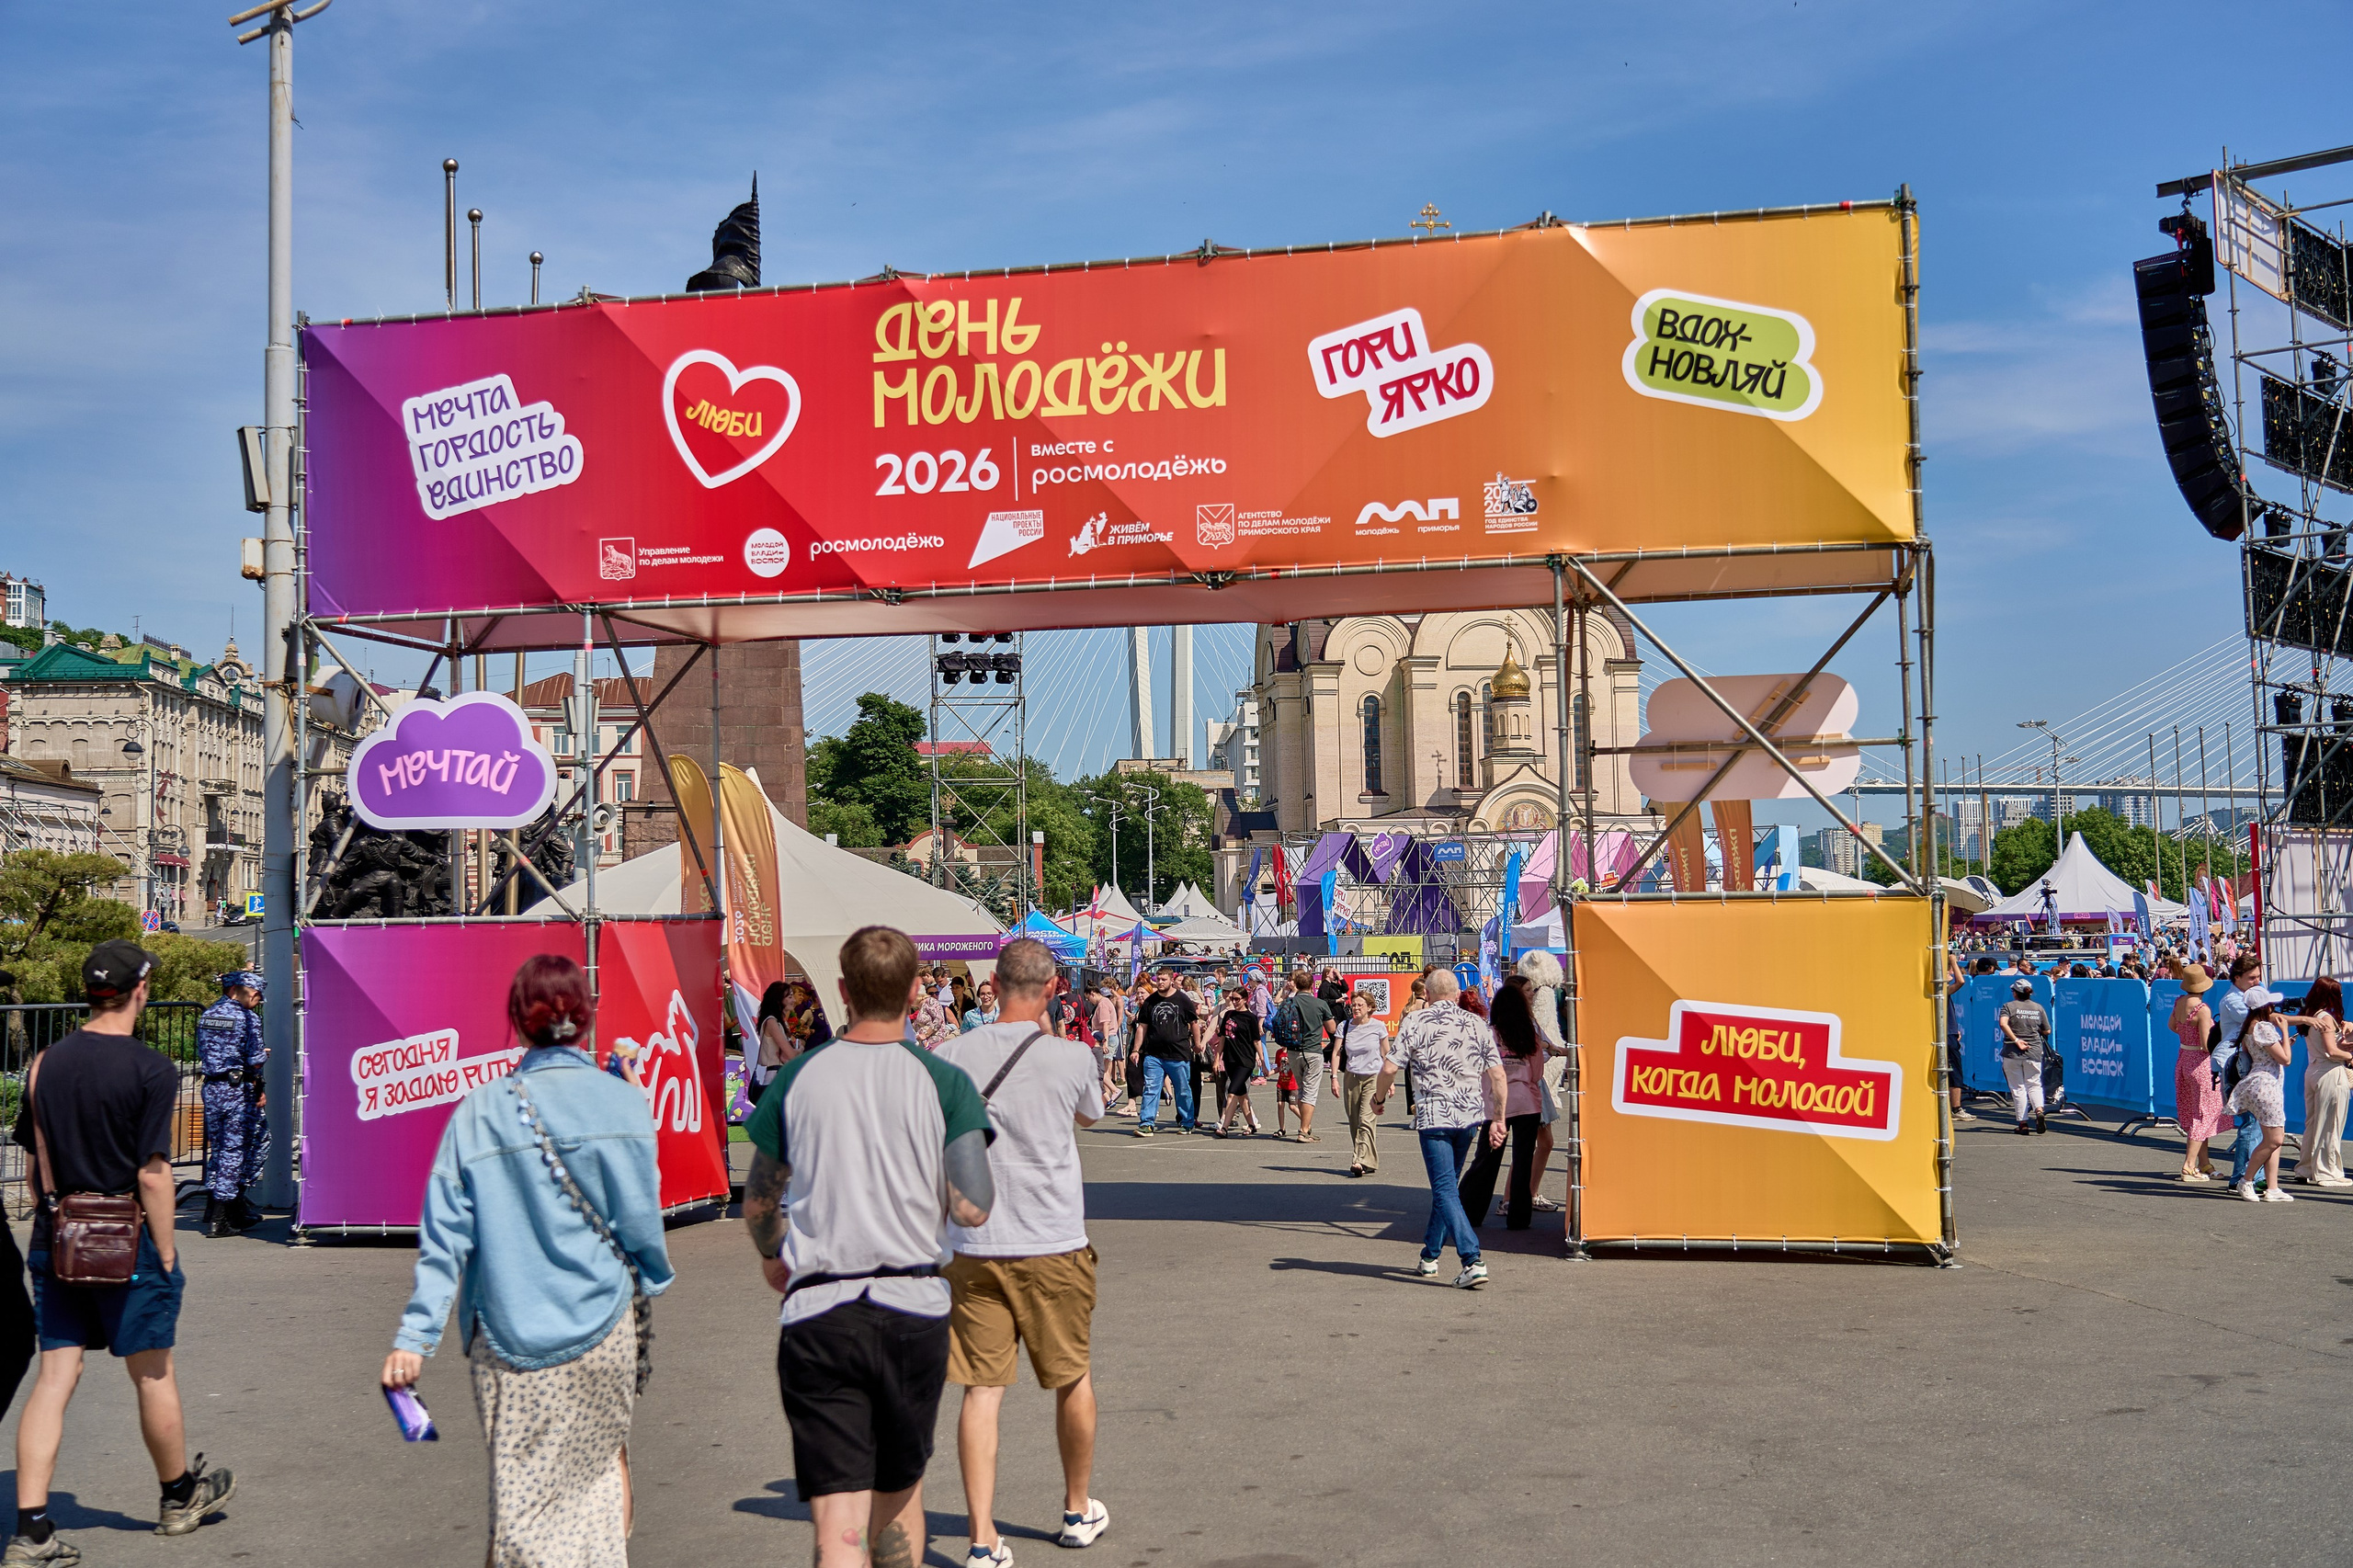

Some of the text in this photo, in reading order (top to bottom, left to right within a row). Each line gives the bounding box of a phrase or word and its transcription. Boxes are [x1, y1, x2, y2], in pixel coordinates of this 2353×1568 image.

[873, 298, 1041, 363] ДЕНЬ
[1656, 308, 1752, 352] ВДОХ-
[1321, 322, 1417, 384] ГОРИ
[1648, 347, 1787, 400] НОВЛЯЙ
[873, 341, 1226, 427] МОЛОДЁЖИ
[1380, 358, 1480, 425] ЯРКО
[413, 385, 510, 434] МЕЧТА
[685, 400, 763, 437] ЛЮБИ
[418, 413, 555, 472] ГОРДОСТЬ
[1031, 439, 1114, 457] вместе с
[426, 445, 574, 510] ЕДИНСТВО
[875, 449, 1000, 495] 2026
[1032, 454, 1226, 494] росмолодёжь
[1483, 486, 1501, 500] 20
[1238, 511, 1282, 519] АГЕНТСТВО
[1483, 500, 1501, 513] 26
[991, 511, 1041, 521] НАЦИОНАЛЬНЫЕ
[1013, 520, 1041, 528] ПРОЕКТЫ
[1251, 519, 1280, 528] ДЕЛАМ
[1281, 517, 1331, 526] МОЛОДЁЖИ
[1018, 528, 1042, 537] РОССИИ
[1109, 521, 1149, 534] ЖИВЁМ
[1238, 526, 1321, 536] ПРИМОРСКОГО КРАЯ
[1355, 525, 1460, 536] молодёжь приморья
[811, 533, 944, 562] росмолодёжь
[1108, 532, 1173, 545] В ПРИМОРЬЕ
[639, 547, 690, 557] Управление
[652, 557, 678, 566] делам
[680, 555, 723, 564] молодежи
[379, 749, 521, 796] МЕЧТАЙ
[1335, 888, 1346, 902] ОРИ
[937, 941, 993, 951] МОРОЖЕНОГО
[205, 1019, 234, 1028] РОСГВАРДИЯ
[2081, 1015, 2121, 1032] МОЛОДОЙ
[1700, 1024, 1805, 1070] ЛЮБИ,
[358, 1038, 450, 1079] СЕГОДНЯ
[2082, 1058, 2123, 1076] ВОСТОК
[366, 1086, 378, 1112] Я
[384, 1068, 458, 1108] ЗАДАЮ
[1631, 1064, 1875, 1117] КОГДА МОЛОДОЙ
